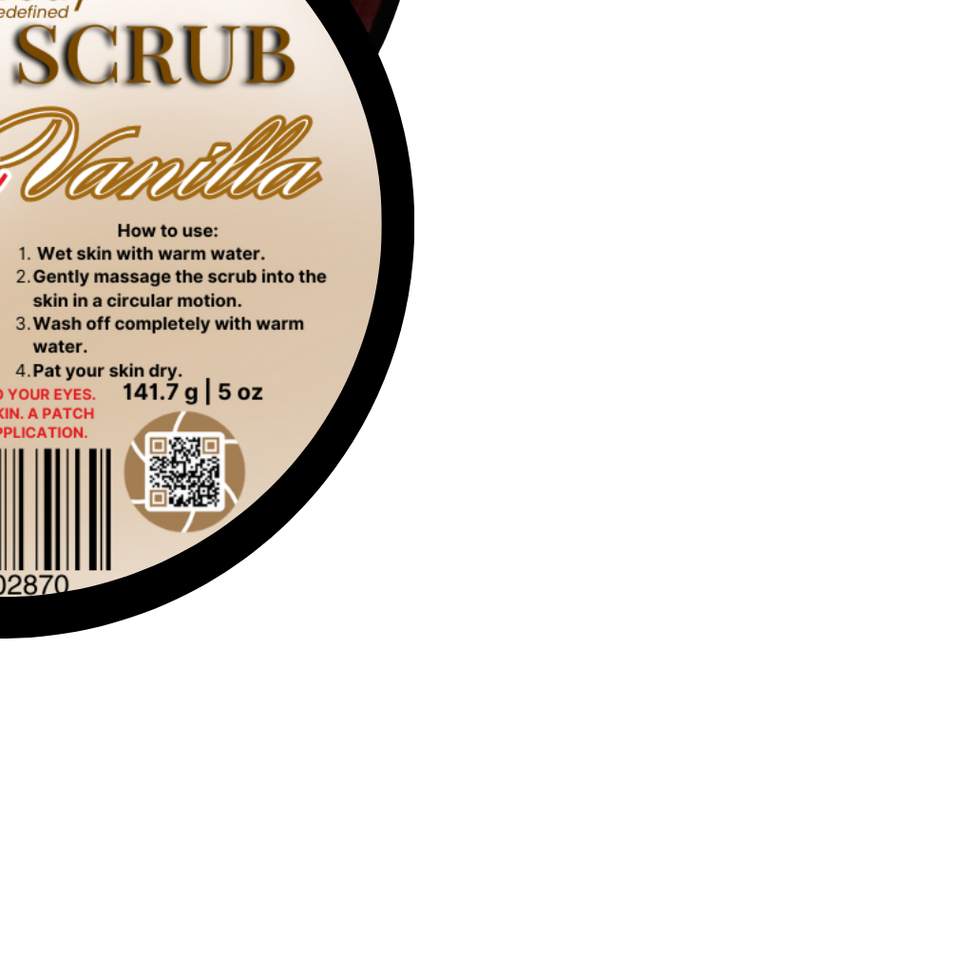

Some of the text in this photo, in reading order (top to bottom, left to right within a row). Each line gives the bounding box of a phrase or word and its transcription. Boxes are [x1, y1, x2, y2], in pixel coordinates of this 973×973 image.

[13, 23, 296, 87] SCRUB
[117, 223, 219, 238] How to use:
[36, 246, 73, 261] Wet
[76, 245, 113, 261] skin
[116, 245, 154, 261] with
[157, 249, 207, 261] warm
[210, 247, 266, 261] water.
[32, 268, 90, 288] Gently
[93, 271, 172, 288] massage
[174, 269, 204, 284] the
[207, 269, 258, 284] scrub
[261, 268, 295, 284] into
[298, 269, 327, 284] the
[32, 292, 242, 308] skin in a circular motion.
[32, 316, 82, 331] Wash
[85, 315, 112, 331] off
[114, 316, 211, 335] completely
[214, 315, 252, 331] with
[255, 319, 305, 331] warm
[32, 339, 88, 354] water.
[32, 363, 62, 378] Pat
[65, 366, 105, 381] your
[108, 362, 145, 378] skin
[148, 363, 183, 381] dry.
[7, 388, 50, 401] YOUR
[53, 388, 96, 401] EYES.
[122, 382, 179, 401] 141.7
[184, 386, 199, 406] g
[218, 382, 232, 401] 5
[237, 386, 264, 401] oz
[27, 407, 39, 420] A
[42, 407, 94, 420] PATCH
